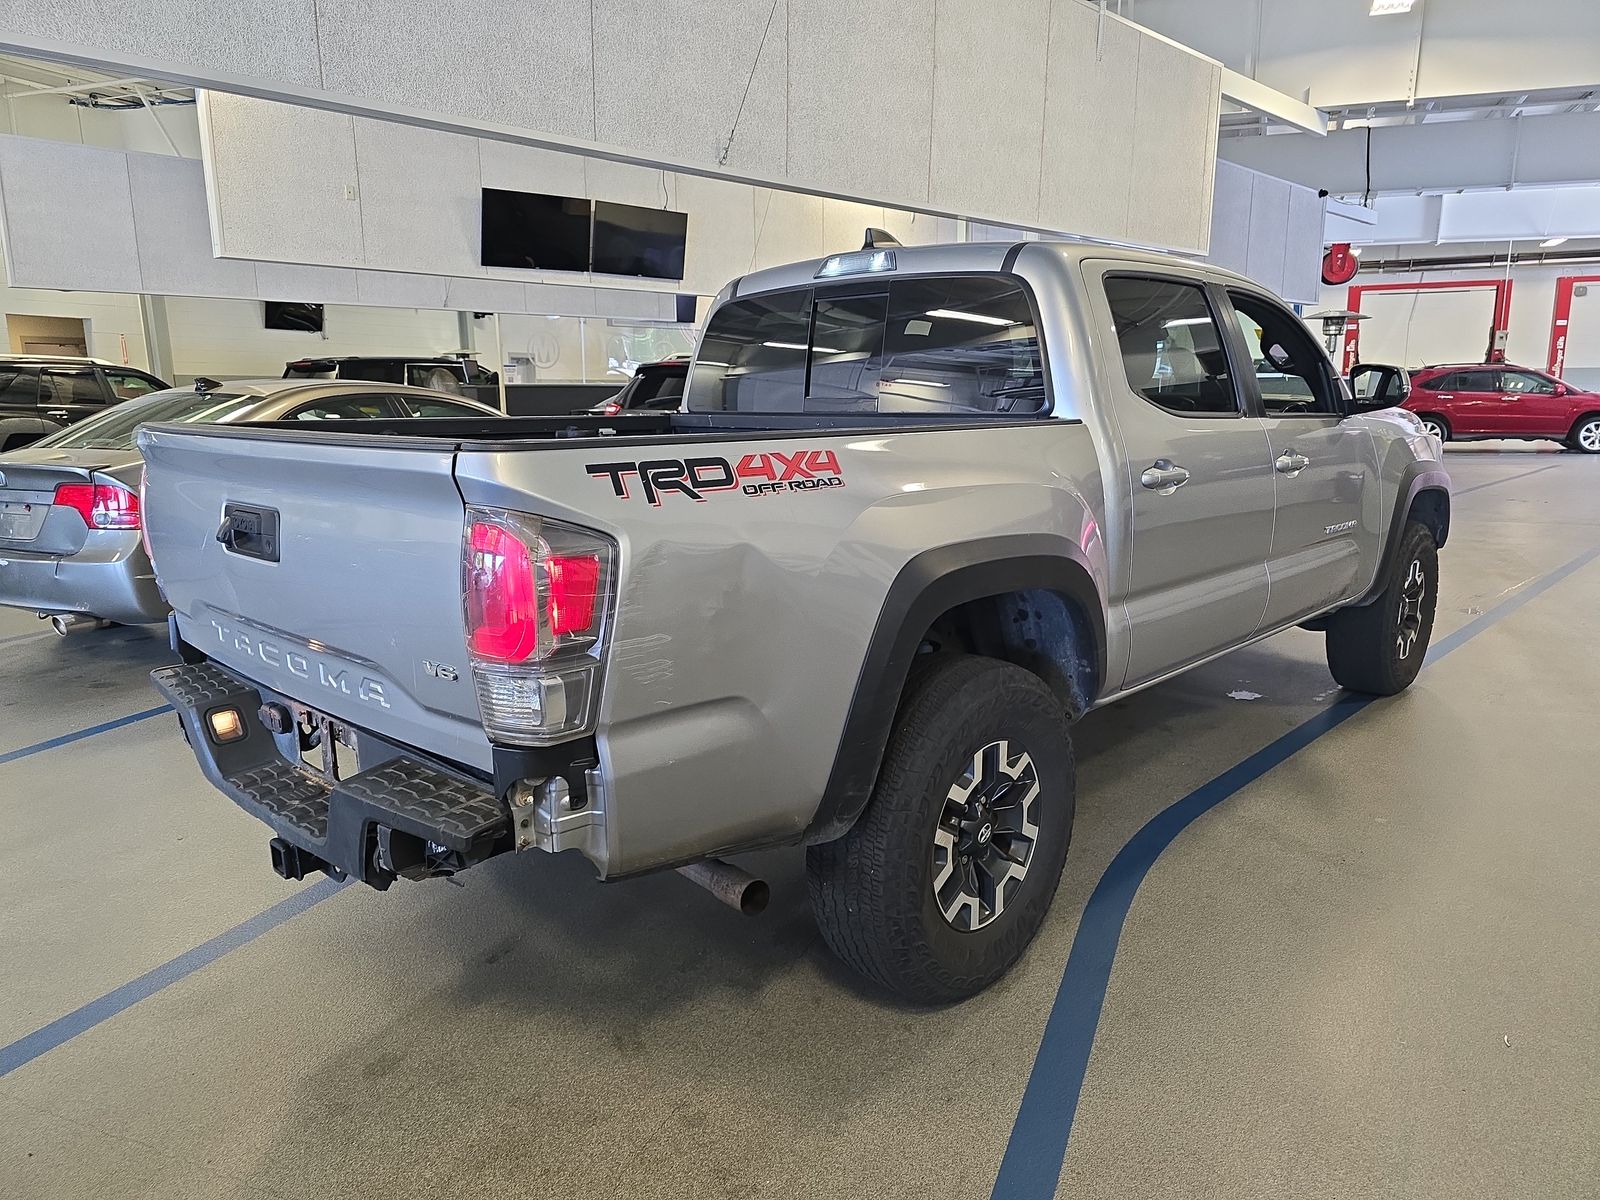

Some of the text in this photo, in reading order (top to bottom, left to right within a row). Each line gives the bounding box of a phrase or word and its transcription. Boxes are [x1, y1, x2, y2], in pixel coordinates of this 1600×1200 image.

[585, 456, 738, 506] TRD
[742, 477, 844, 496] OFF ROAD
[211, 620, 391, 709] TACOMA
[422, 660, 458, 681] V6
